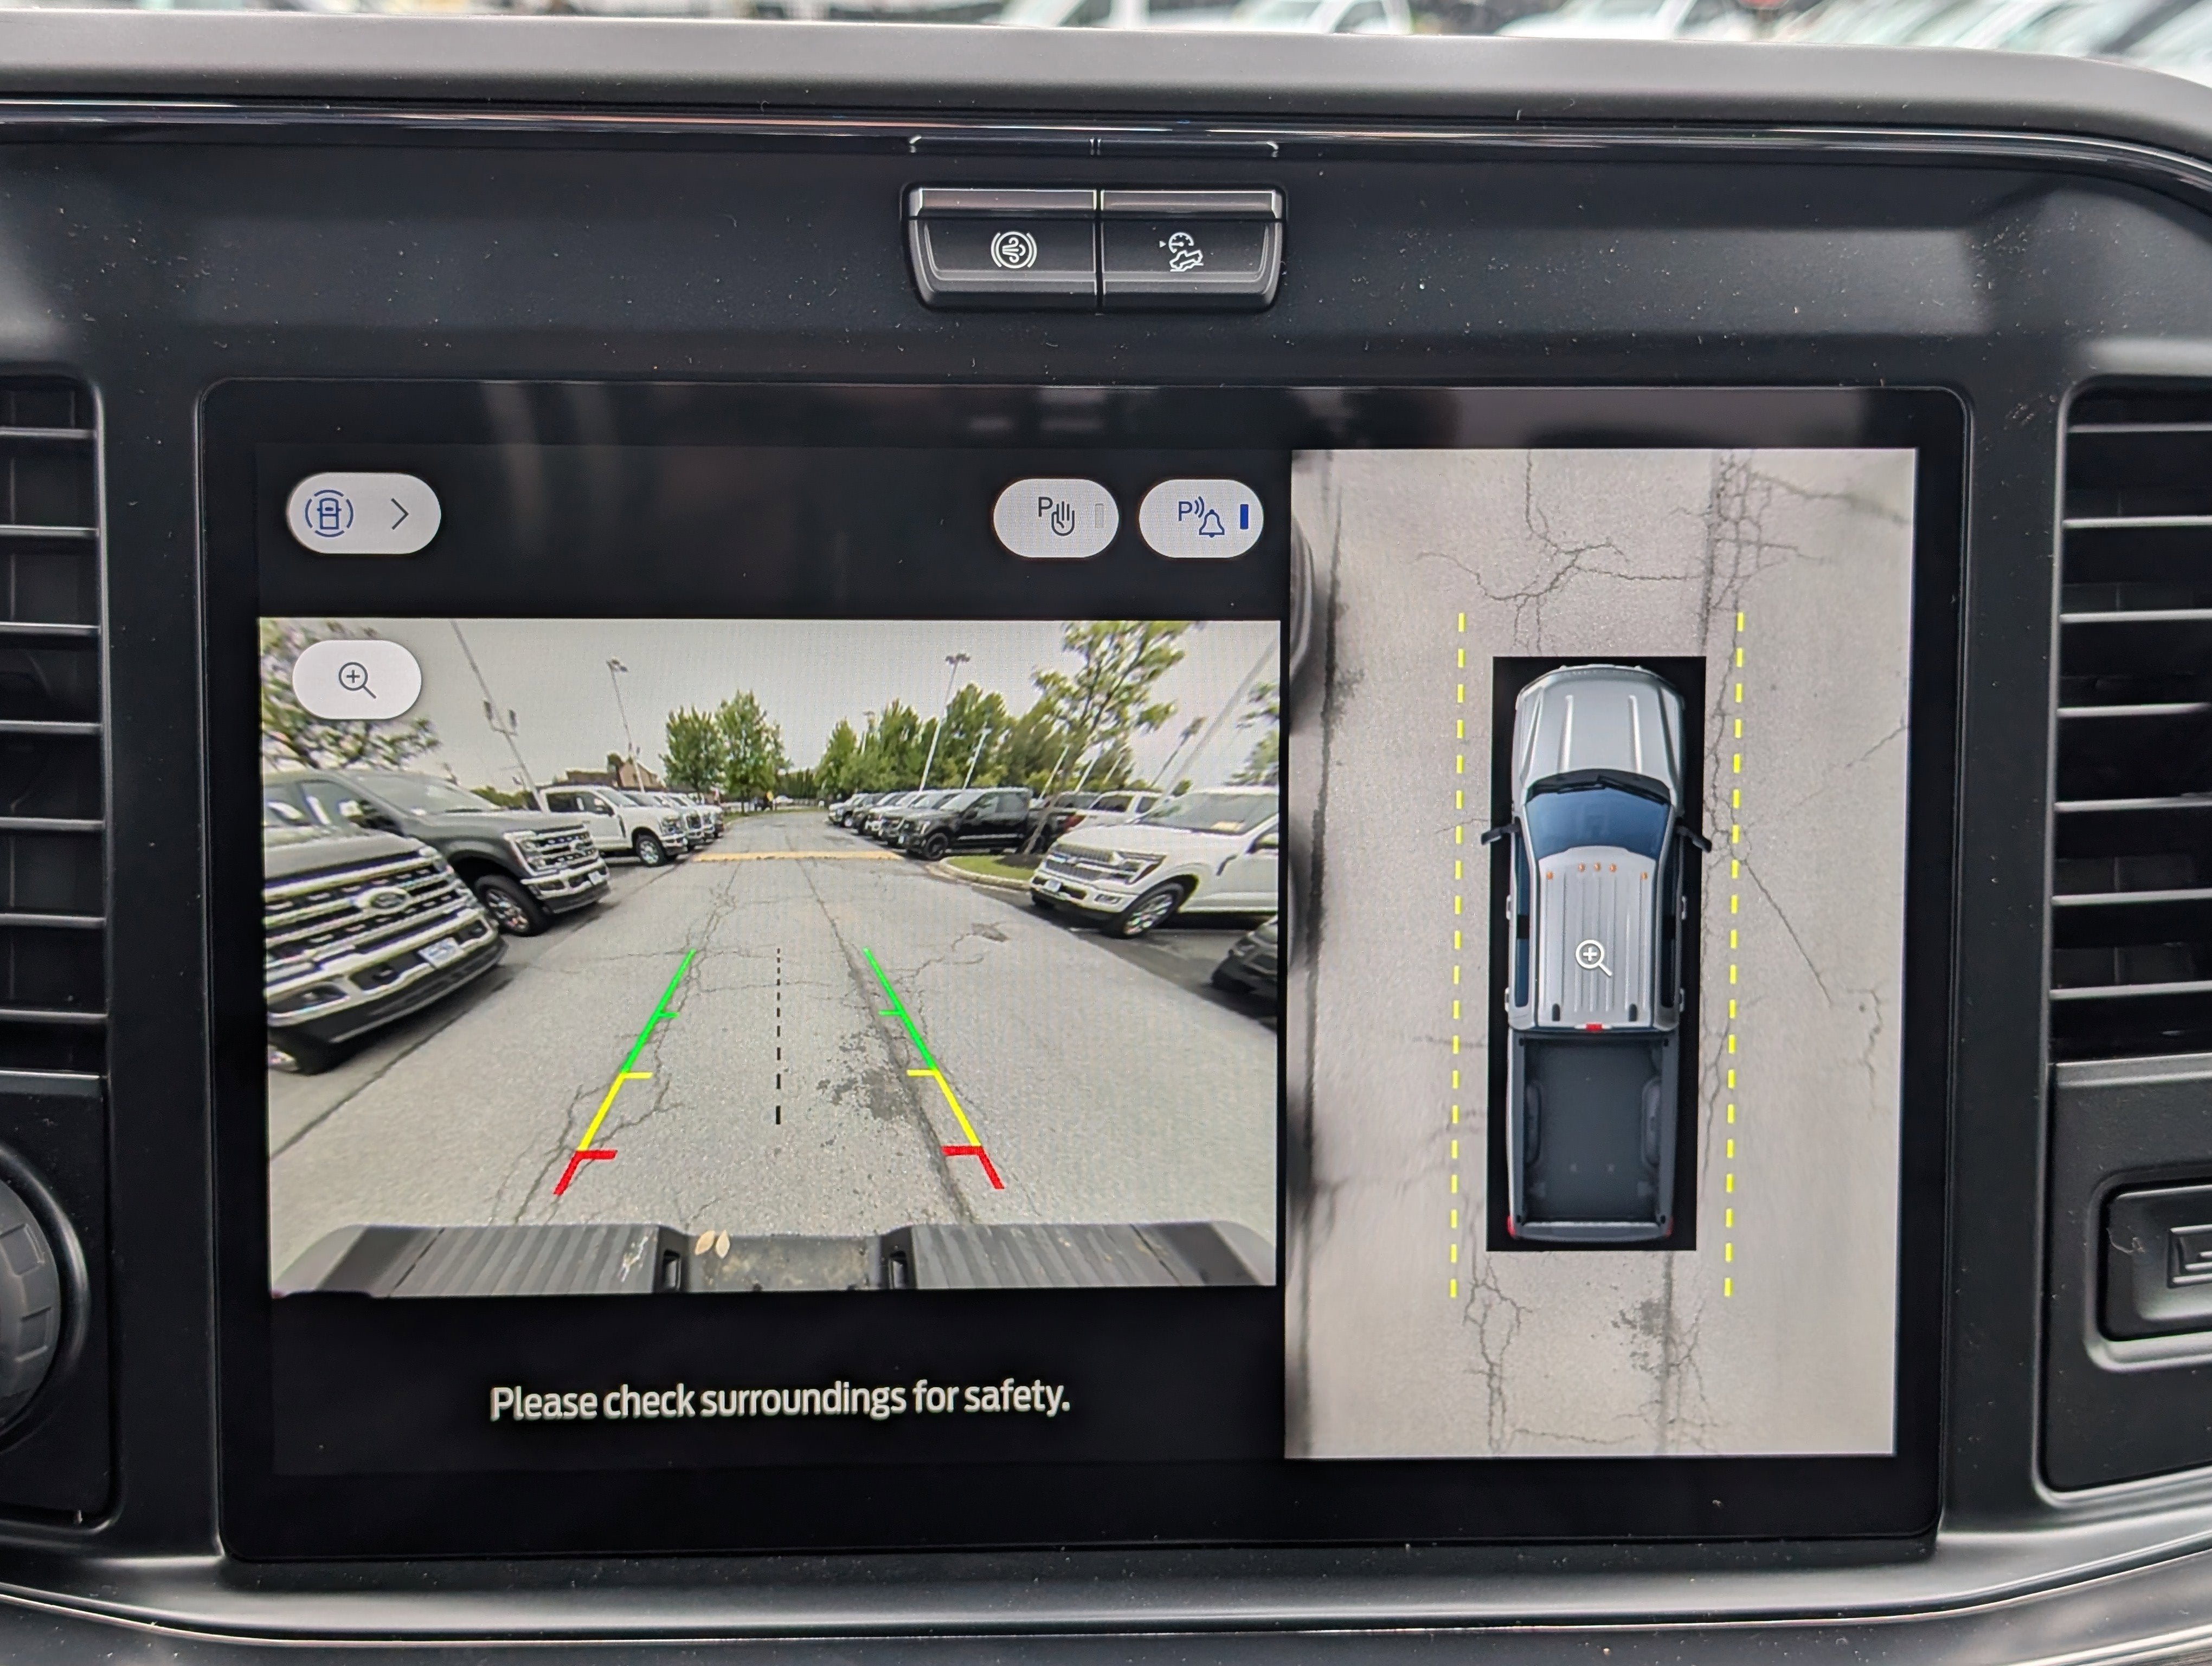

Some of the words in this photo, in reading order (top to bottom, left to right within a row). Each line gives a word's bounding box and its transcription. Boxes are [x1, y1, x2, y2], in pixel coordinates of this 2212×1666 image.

[1038, 496, 1053, 517] P
[1178, 501, 1193, 522] P
[490, 1386, 598, 1421] Please
[603, 1382, 696, 1419] check
[699, 1380, 908, 1420] surroundings
[912, 1379, 960, 1414] for
[963, 1377, 1071, 1418] safety.
